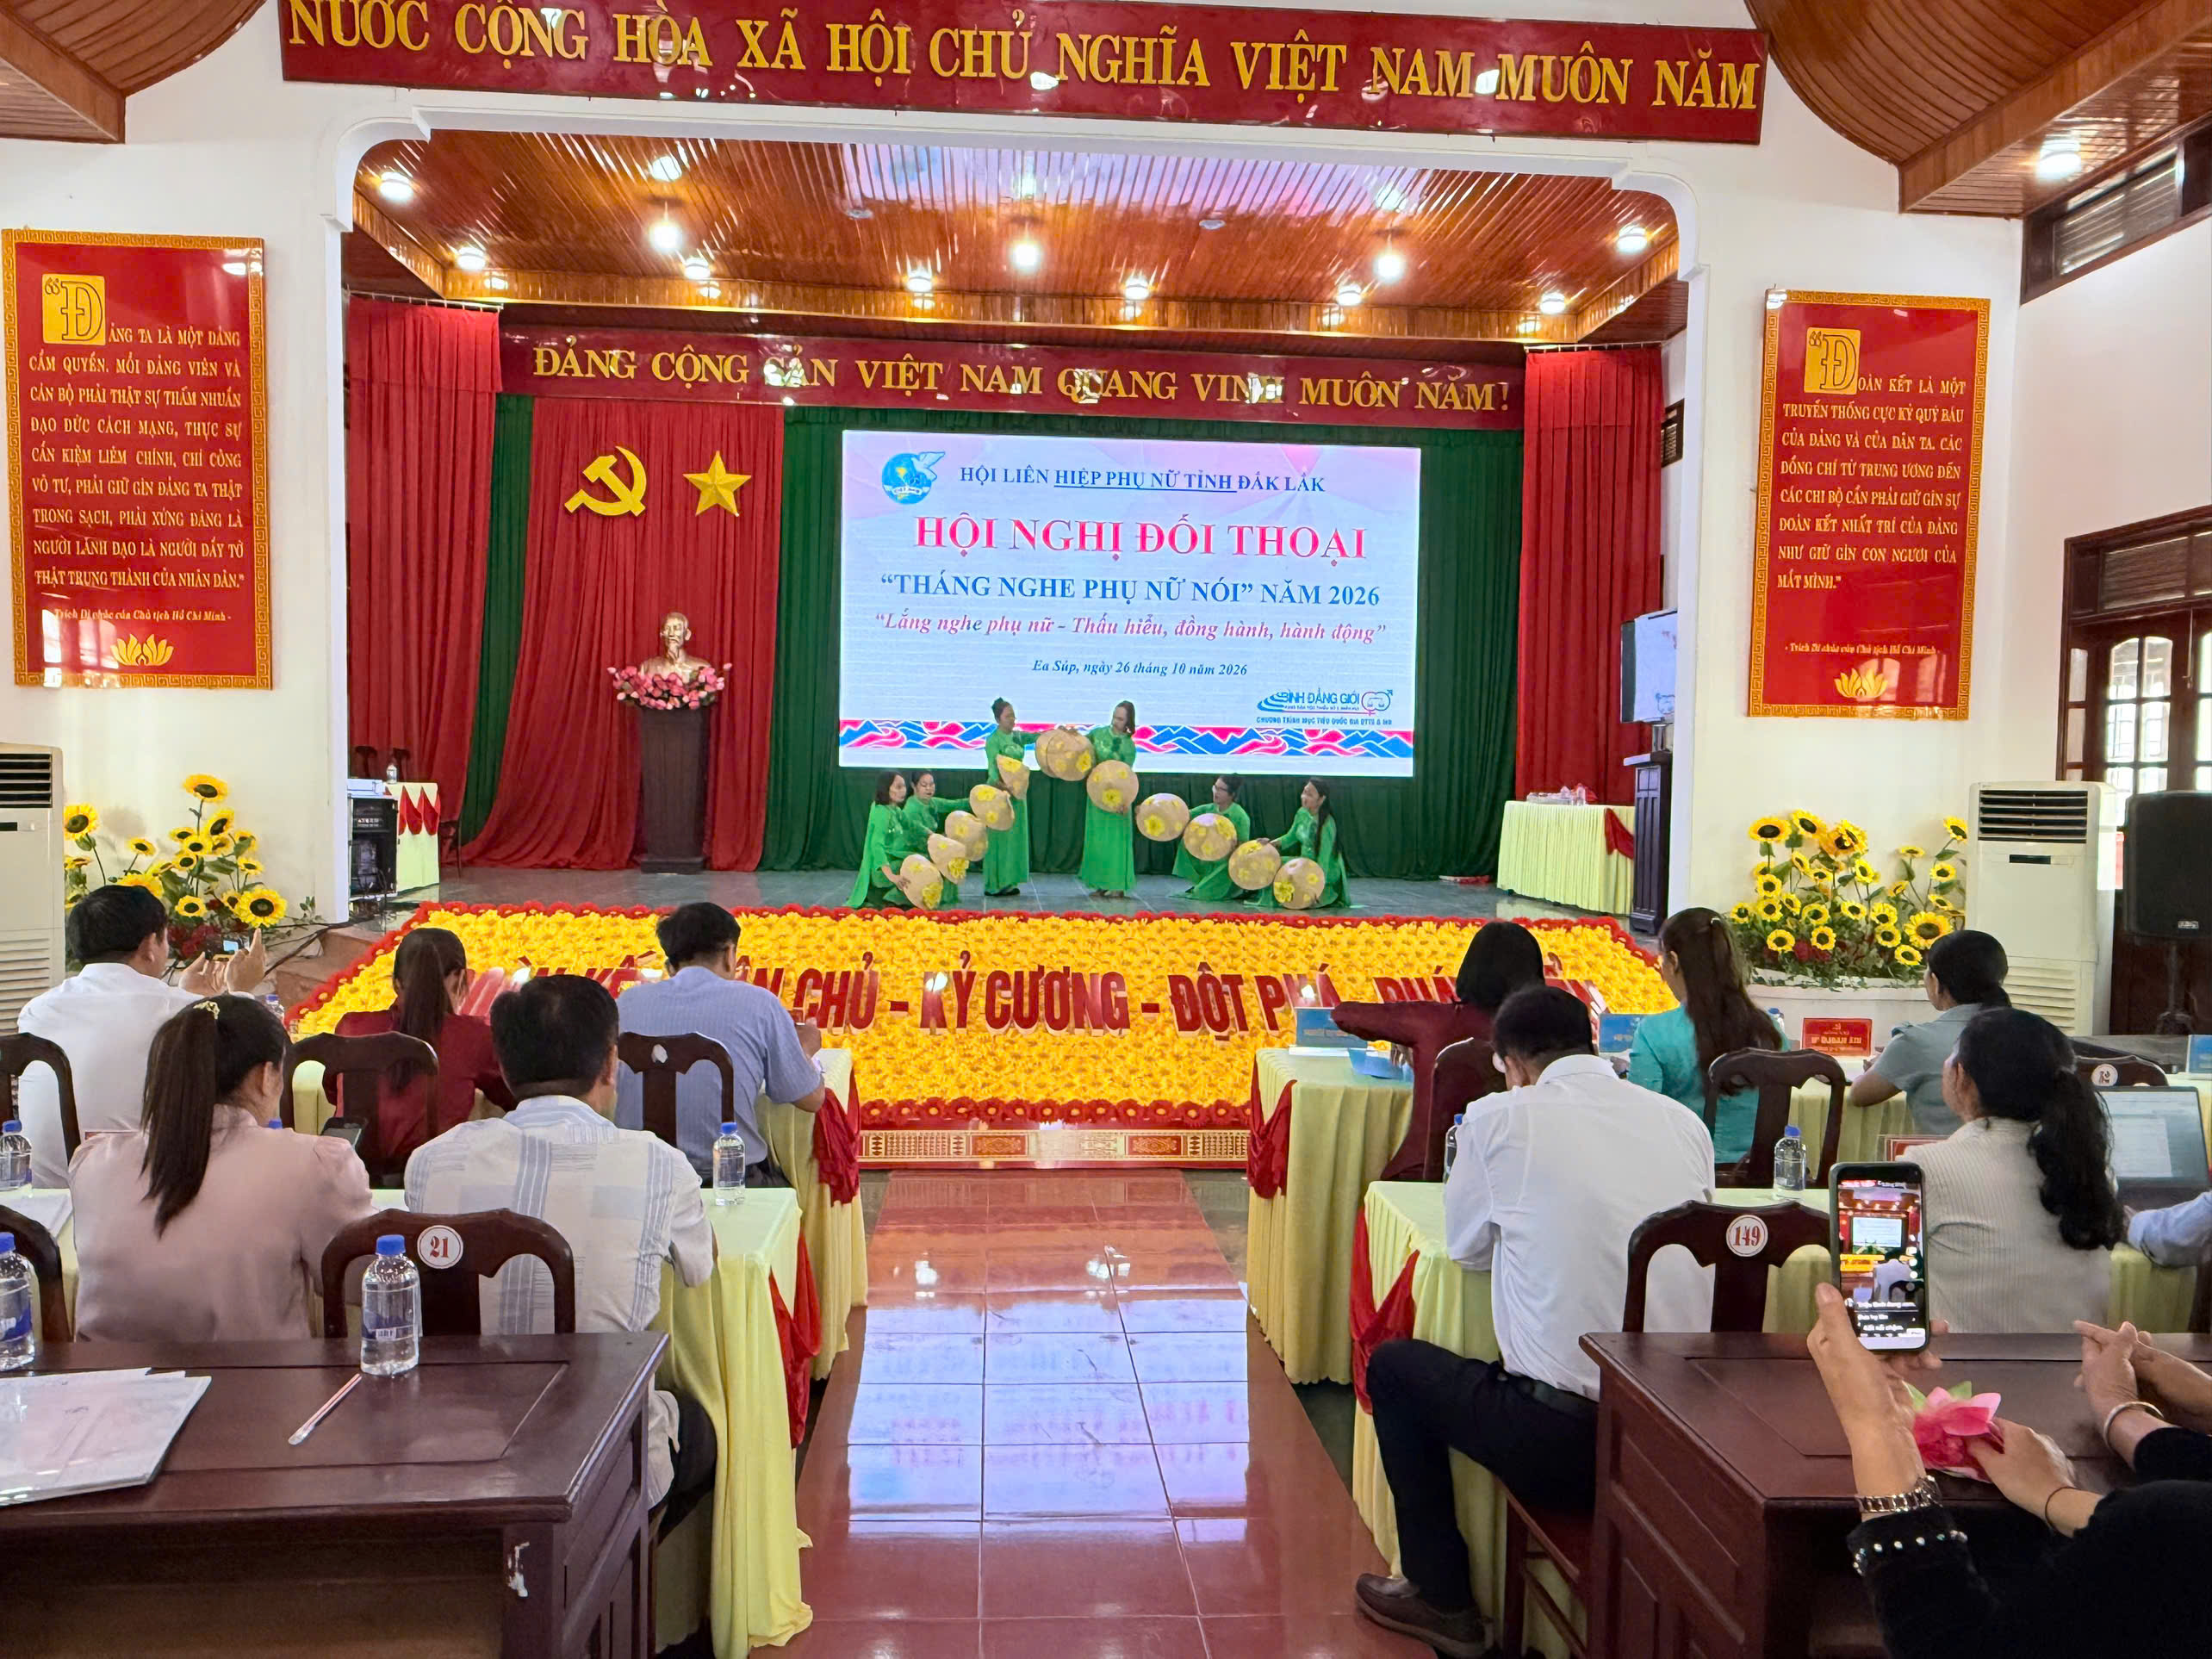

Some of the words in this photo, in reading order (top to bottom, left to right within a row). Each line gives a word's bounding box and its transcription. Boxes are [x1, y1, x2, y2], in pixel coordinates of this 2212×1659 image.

[455, 0, 588, 69] CỘNG
[612, 0, 713, 66] HÒA
[736, 8, 806, 69] XÃ
[827, 8, 911, 89] HỘI
[929, 9, 1034, 80] CHỦ
[1057, 25, 1210, 87] NGHĨA
[1230, 26, 1347, 104] VIỆT
[1370, 47, 1475, 98] NAM
[1495, 40, 1633, 104] MUÔN
[1653, 49, 1761, 110] NĂM
[138, 329, 152, 344] TA
[533, 338, 635, 379] ĐẢNG
[652, 345, 748, 389] CỘNG
[855, 353, 944, 395] VIỆT
[960, 363, 1043, 395] NAM
[1057, 368, 1178, 403] QUANG
[1190, 372, 1284, 403] VINH
[1300, 370, 1401, 407] MUÔN
[145, 388, 161, 409] SỰ
[184, 421, 219, 442] THỰC
[225, 421, 242, 442] SỰ
[960, 464, 997, 486] HỘI
[1003, 464, 1049, 483] LIÊN
[1055, 467, 1101, 488] HIỆP
[1106, 471, 1145, 488] PHỤ
[1151, 469, 1180, 488] NỮ
[1184, 469, 1232, 489] TỈNH
[1817, 458, 1837, 475] CHÍ
[1860, 463, 1898, 477] TRUNG
[194, 482, 208, 498] TA
[1805, 489, 1825, 504] CHI
[1945, 491, 1960, 510] SỰ
[33, 508, 73, 525] TRONG
[78, 509, 113, 528] SẠCH,
[228, 508, 243, 528] LÀ
[1877, 516, 1896, 534] TRÍ
[34, 535, 71, 556] NGƯỜI
[140, 538, 156, 557] LÀ
[159, 538, 196, 559] NGƯỜI
[914, 512, 997, 557] HỘI
[1010, 519, 1123, 562] NGHỊ
[1135, 513, 1216, 555] ĐỐI
[1227, 525, 1368, 567] THOẠI
[1778, 544, 1803, 560] NHƯ
[1862, 548, 1886, 562] CON
[67, 570, 109, 587] TRUNG
[152, 567, 177, 587] CỦA
[881, 569, 991, 596] “THÁNG
[998, 576, 1075, 599] NGHE
[1083, 578, 1137, 605] PHỤ
[1145, 576, 1186, 600] NỮ
[1192, 576, 1253, 602] NÓI”
[1261, 579, 1321, 604] NĂM
[1328, 586, 1380, 606] 2026
[875, 608, 930, 633] “Lắng
[937, 614, 983, 633] nghe
[985, 616, 1022, 636] phụ
[1028, 617, 1054, 633] nữ
[1072, 612, 1119, 635] Thấu
[1124, 613, 1168, 637] hiểu,
[1175, 614, 1218, 639] đồng
[1223, 620, 1274, 640] hành,
[1280, 622, 1325, 639] hành
[1331, 624, 1386, 644] động”
[1032, 660, 1049, 672] Ea
[1053, 660, 1079, 674] Súp,
[1084, 662, 1113, 675] ngày
[1115, 662, 1130, 674] 26
[1134, 662, 1167, 676] tháng
[1172, 662, 1186, 674] 10
[1189, 663, 1215, 675] năm
[1219, 664, 1248, 676] 2026
[793, 950, 879, 1029] CHỦ
[921, 949, 977, 1029] KỶ
[985, 964, 1131, 1029] CƯƠNG
[1167, 961, 1249, 1041] ĐỘT
[1733, 1225, 1761, 1246] 149
[430, 1236, 449, 1258] 21
